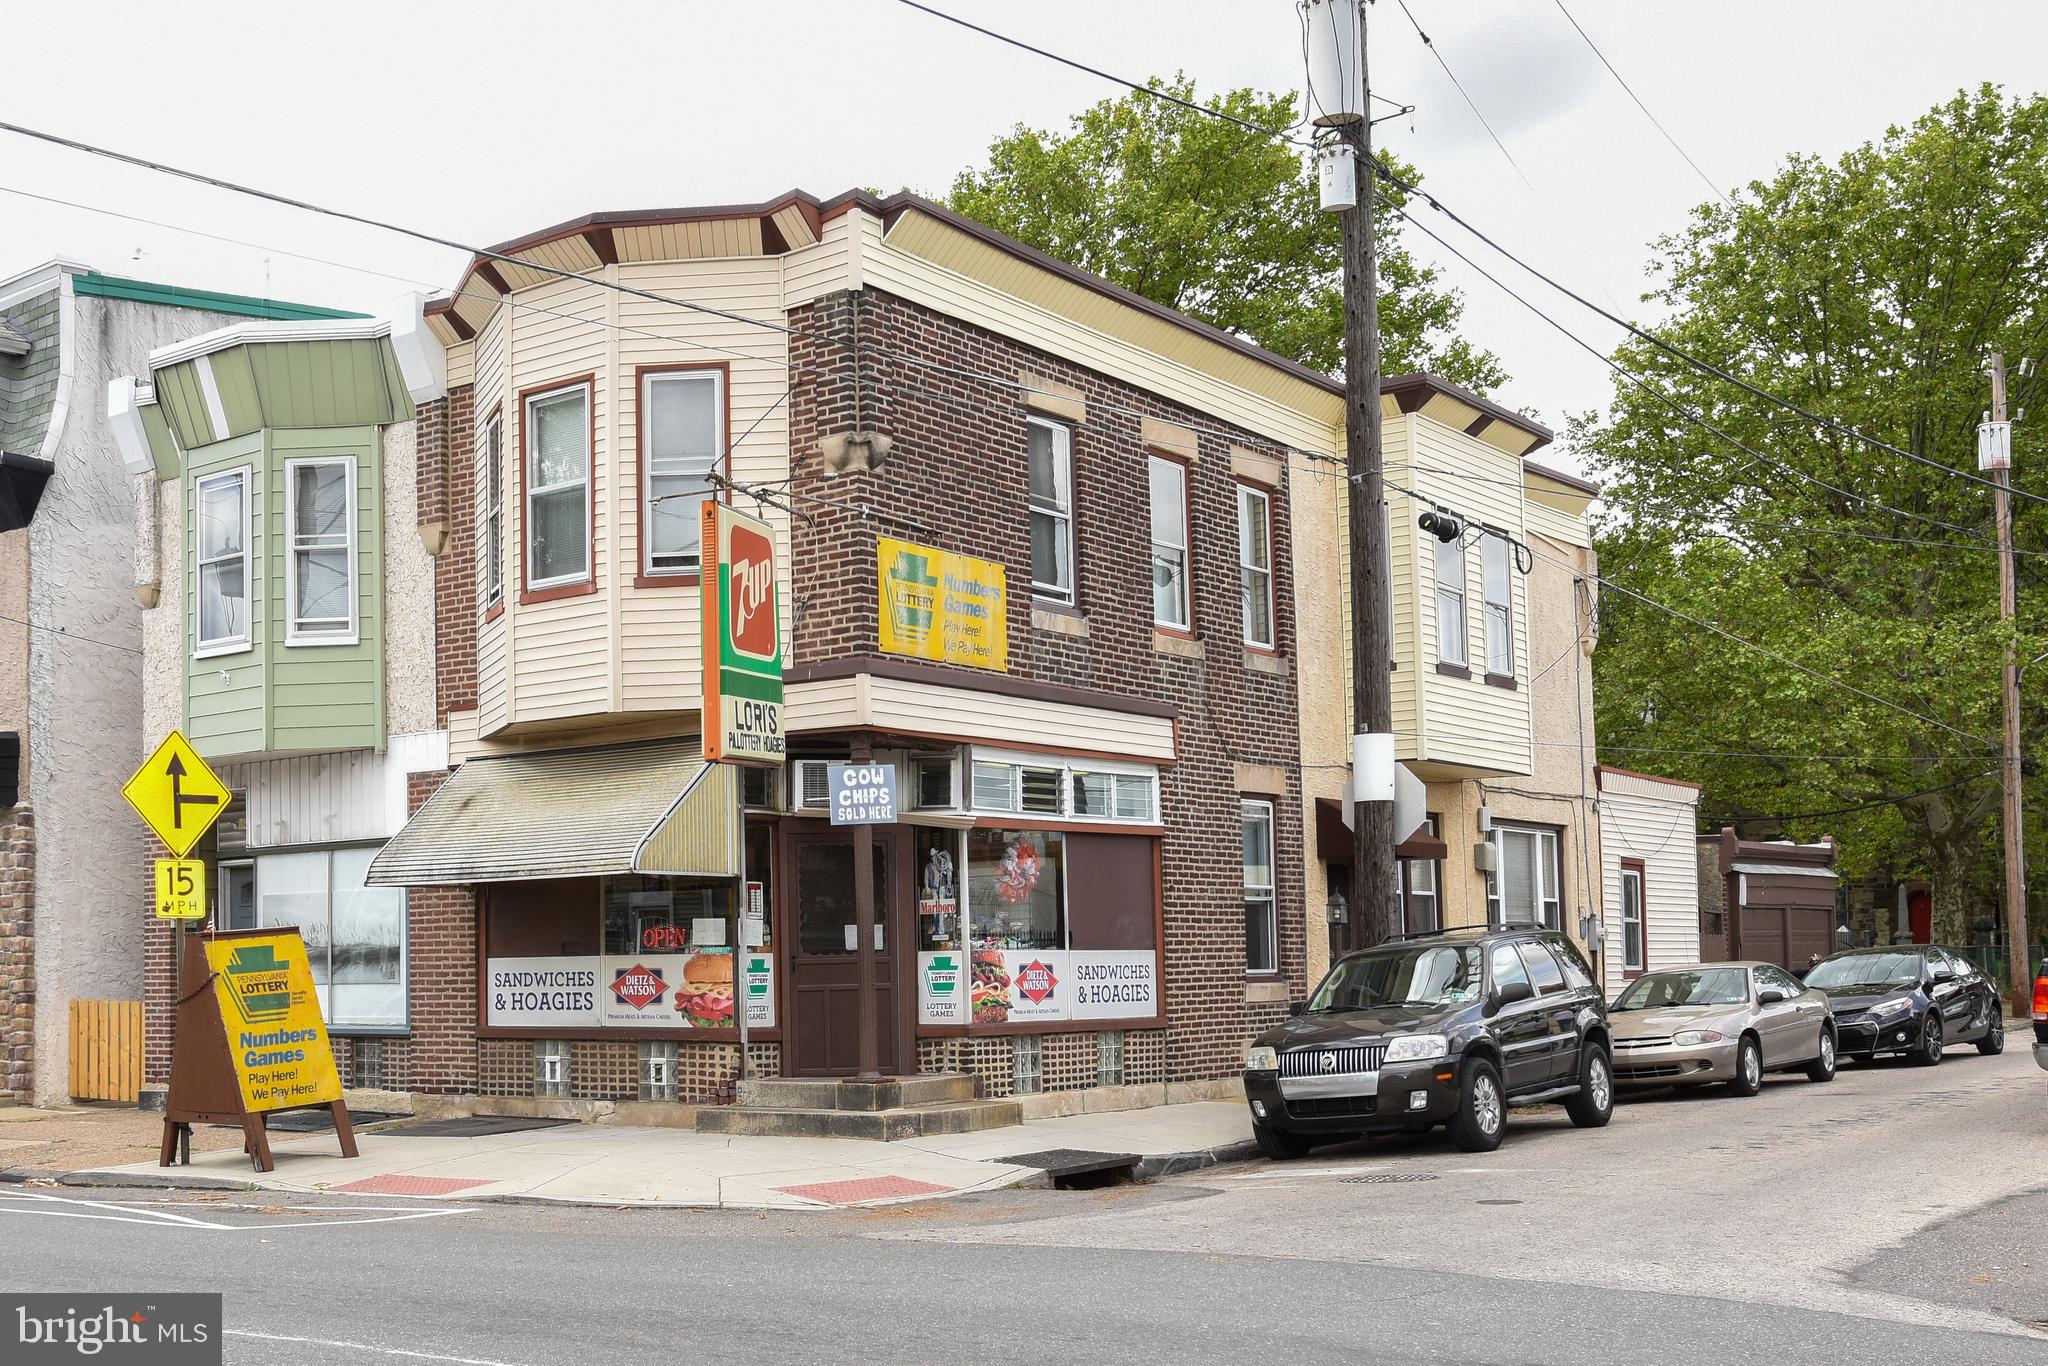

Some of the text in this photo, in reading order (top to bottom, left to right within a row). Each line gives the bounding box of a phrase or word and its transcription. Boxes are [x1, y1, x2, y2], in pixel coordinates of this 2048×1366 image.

[943, 572, 1001, 602] Numbers
[732, 558, 771, 638] 7UP
[895, 591, 935, 609] LOTTERY
[943, 594, 989, 620] Games
[943, 619, 983, 639] Play Here!
[943, 638, 993, 658] We Pay Here!
[735, 700, 777, 735] LORI'S
[763, 735, 785, 753] HOAGIES
[842, 767, 885, 787] COW
[838, 787, 890, 806] CHIPS
[838, 805, 893, 821] SOLD HERE
[166, 866, 194, 897] 15
[165, 900, 197, 912] MPH
[920, 900, 956, 914] Marlboro
[642, 927, 686, 948] OPEN
[237, 970, 289, 984] PENNSYLVANIA
[494, 971, 595, 988] SANDWICHES
[625, 975, 656, 986] DIETZ &
[1026, 969, 1049, 980] DIETZ &
[1077, 964, 1150, 981] SANDWICHES
[239, 980, 289, 995] LOTTERY
[620, 985, 656, 996] WATSON
[1022, 980, 1050, 991] WATSON
[1078, 984, 1150, 1004] & HOAGIES
[495, 992, 594, 1011] & HOAGIES
[929, 1010, 955, 1018] GAMES
[240, 1028, 317, 1049] Numbers
[244, 1049, 305, 1068] Games
[248, 1068, 299, 1086] Play Here!
[252, 1082, 317, 1101] We Pay Here!
